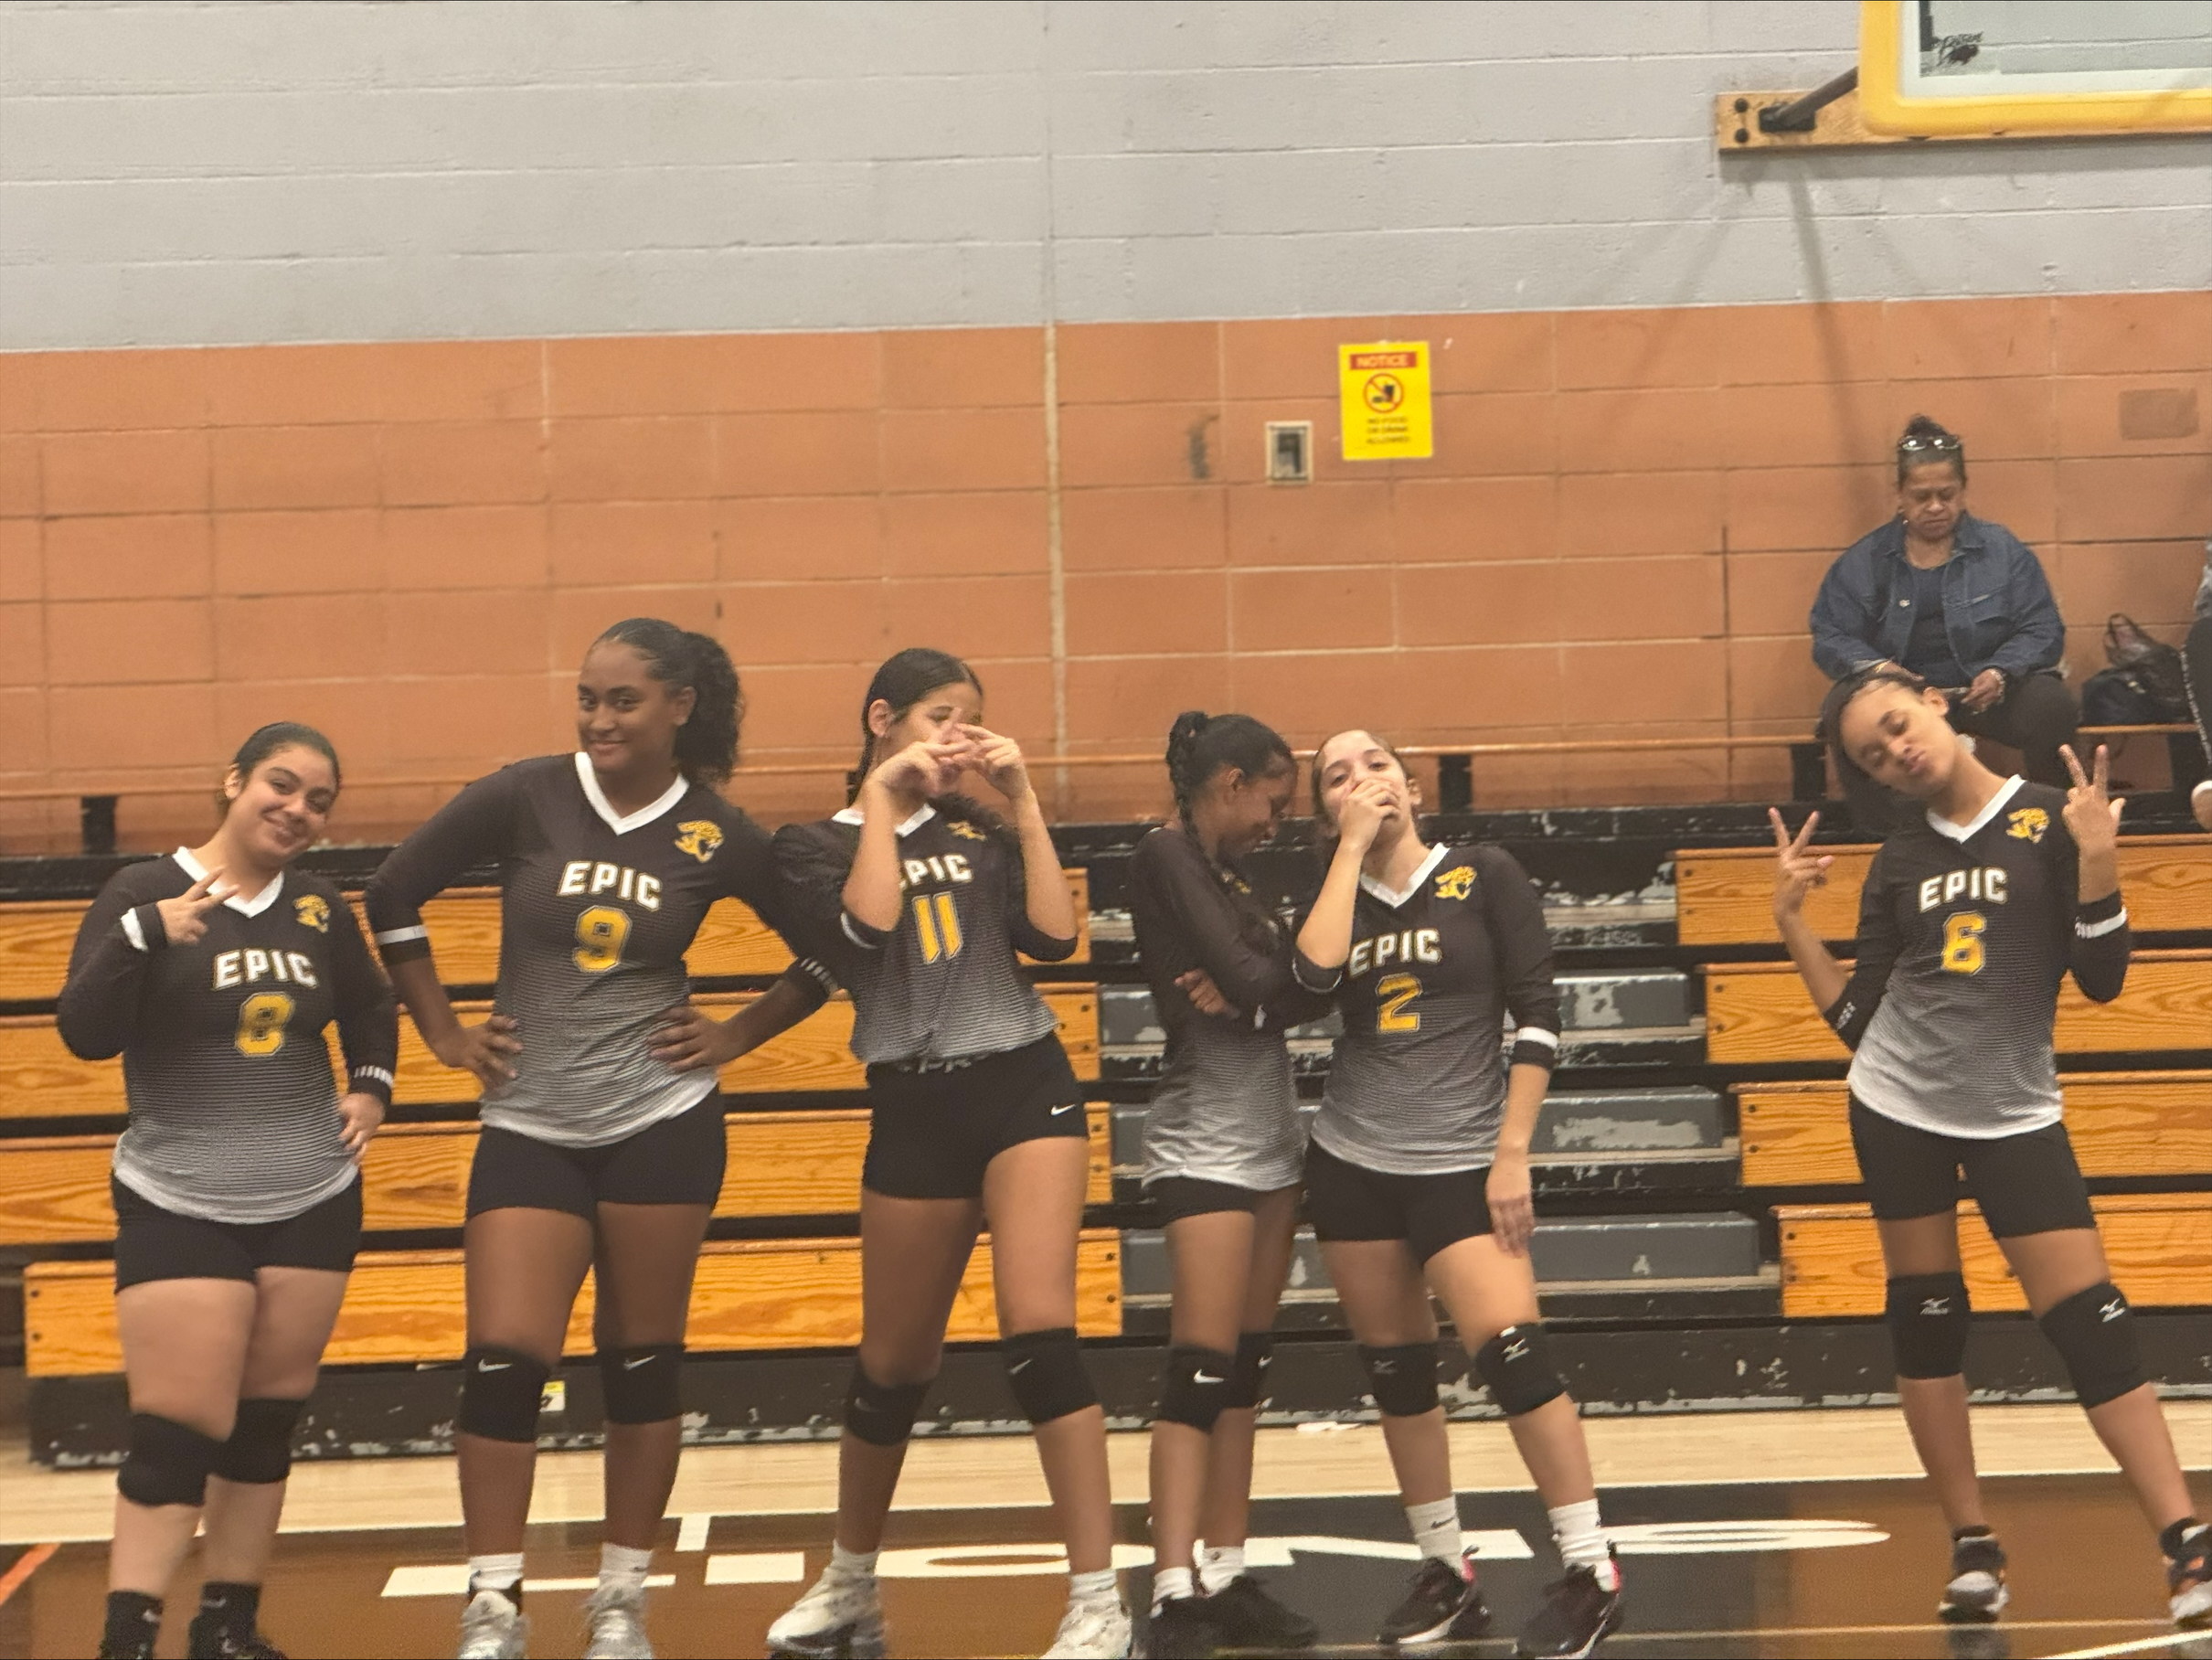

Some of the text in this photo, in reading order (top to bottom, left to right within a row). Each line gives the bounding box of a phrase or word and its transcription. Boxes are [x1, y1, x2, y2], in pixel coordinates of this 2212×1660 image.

[1356, 354, 1408, 367] NOTICE
[557, 861, 663, 912] EPIC
[899, 854, 973, 890] PIC
[1920, 867, 2008, 913] EPIC
[572, 905, 633, 973] 9
[912, 891, 963, 964] 11
[1941, 910, 1986, 975] 6
[212, 948, 319, 991] EPIC
[1348, 928, 1442, 979] EPIC
[235, 991, 295, 1058] 8
[1376, 972, 1422, 1034] 2
